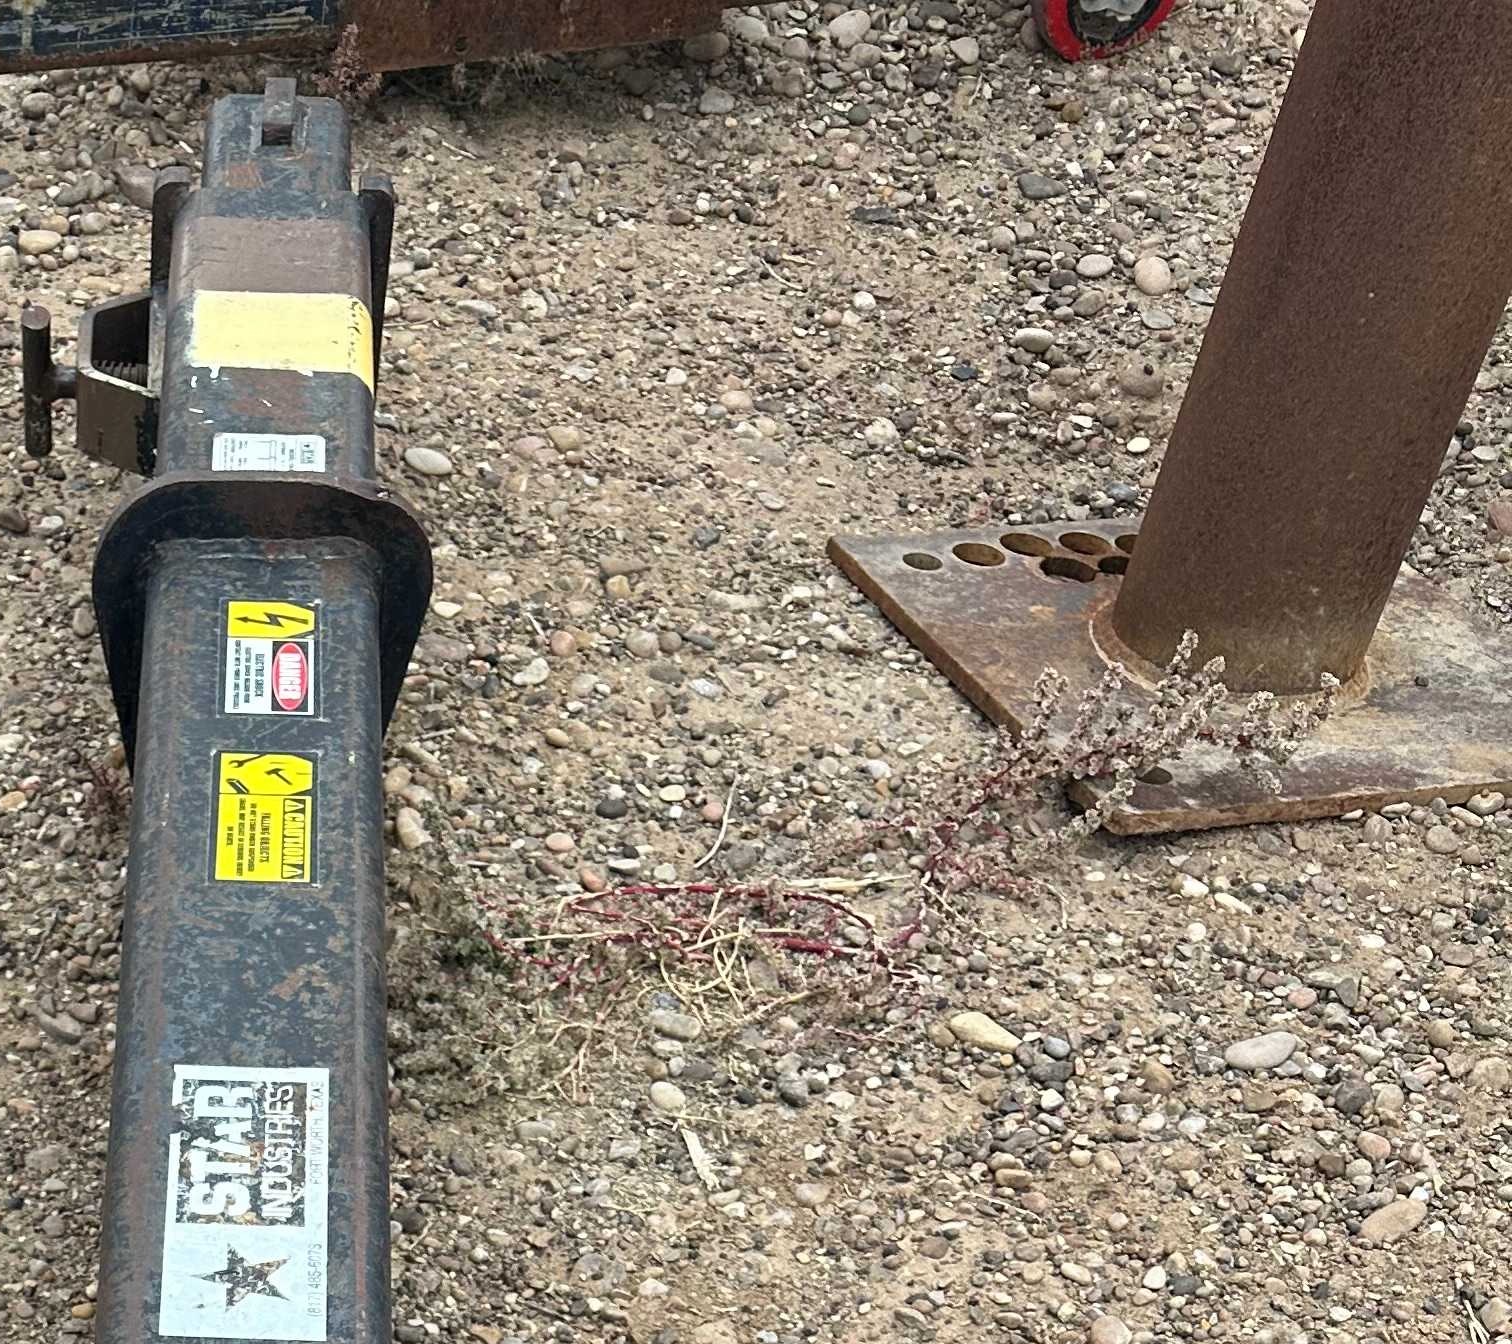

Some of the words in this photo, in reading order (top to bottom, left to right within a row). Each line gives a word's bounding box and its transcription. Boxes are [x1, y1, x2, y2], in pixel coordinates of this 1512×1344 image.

[277, 650, 301, 700] DANGER
[281, 810, 305, 865] CAUTION
[186, 1082, 254, 1219] STAR
[259, 1082, 295, 1221] INDUSTRIES
